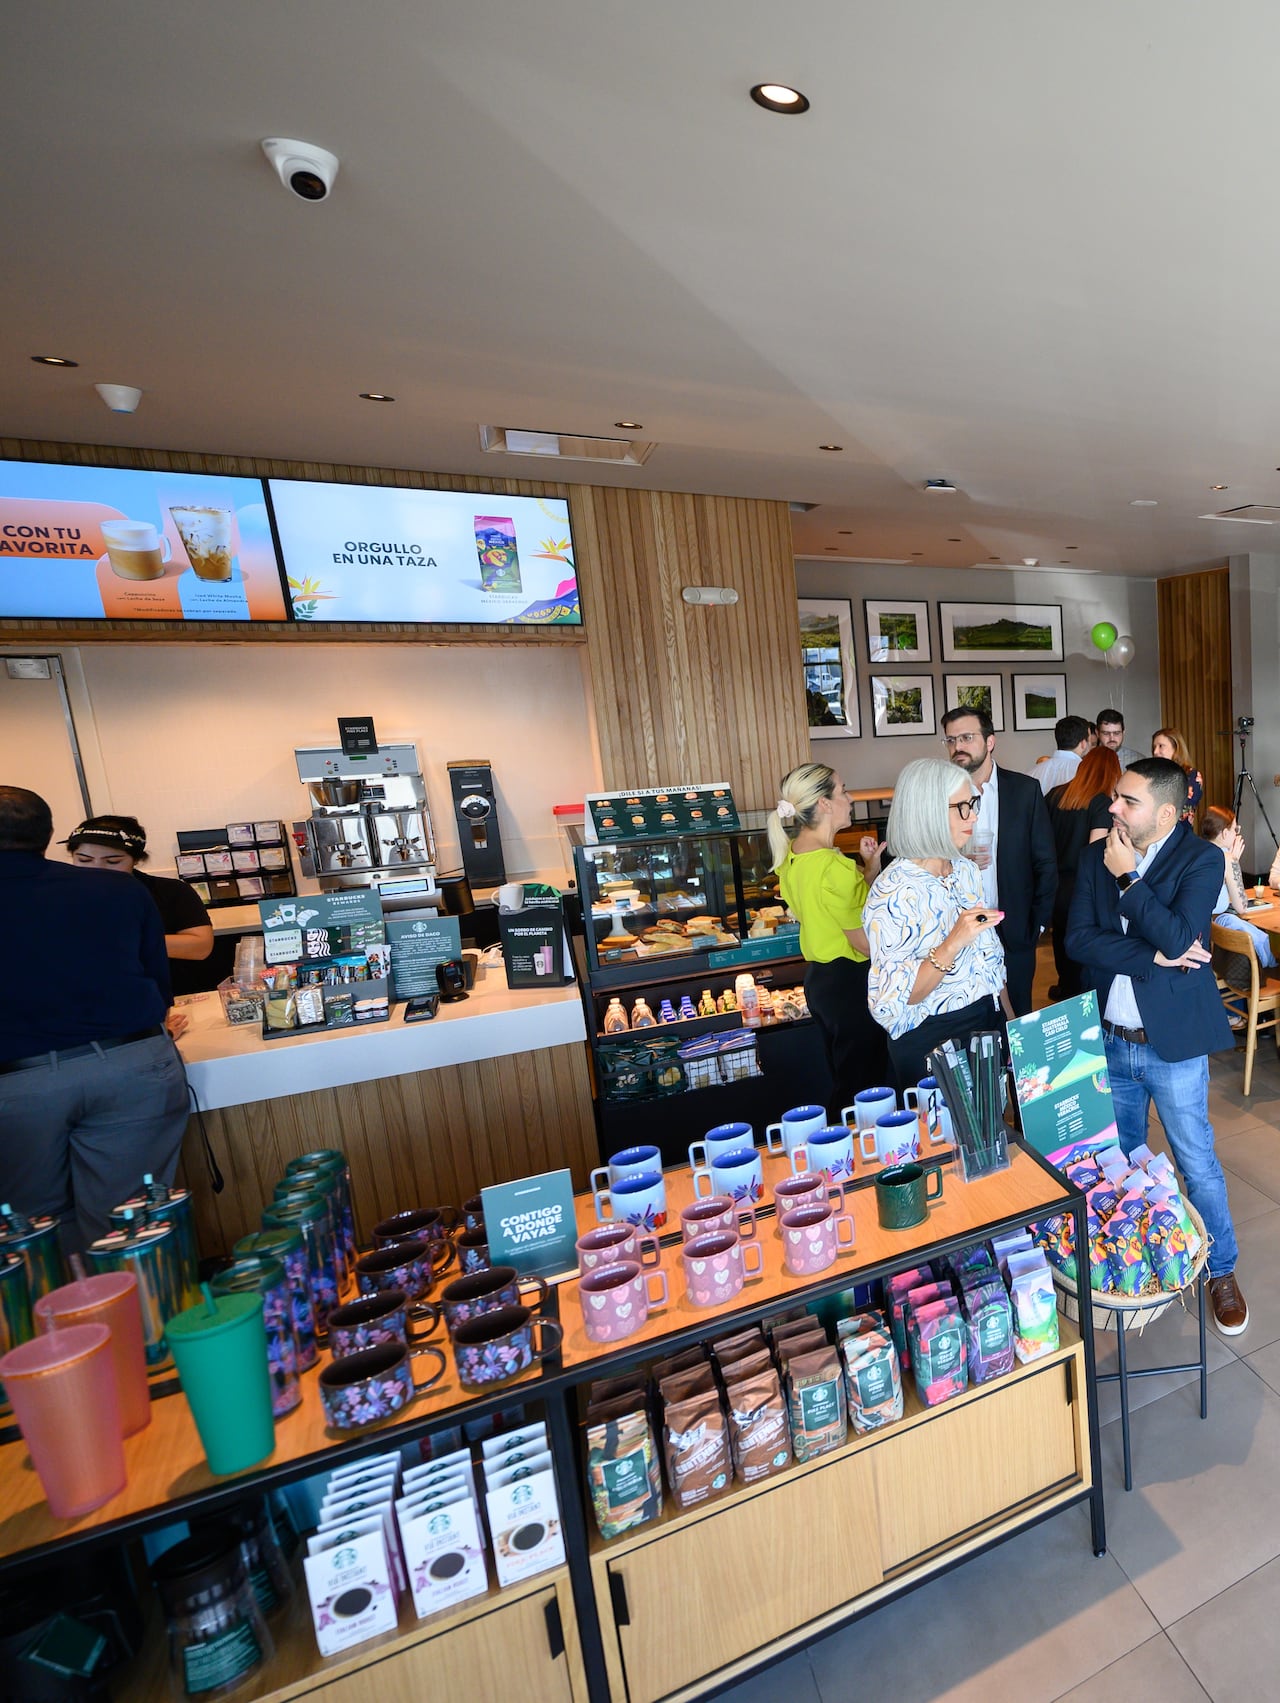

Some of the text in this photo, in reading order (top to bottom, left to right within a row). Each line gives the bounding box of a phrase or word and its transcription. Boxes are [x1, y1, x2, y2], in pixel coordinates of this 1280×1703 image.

[3, 525, 81, 540] CON TU
[344, 541, 422, 554] ORGULLO
[332, 553, 437, 567] EN UNA TAZA
[326, 894, 366, 903] STARBUCKS
[500, 1204, 562, 1228] CONTIGO
[503, 1214, 563, 1237] A DONDE
[511, 1225, 557, 1244] VAYAS
